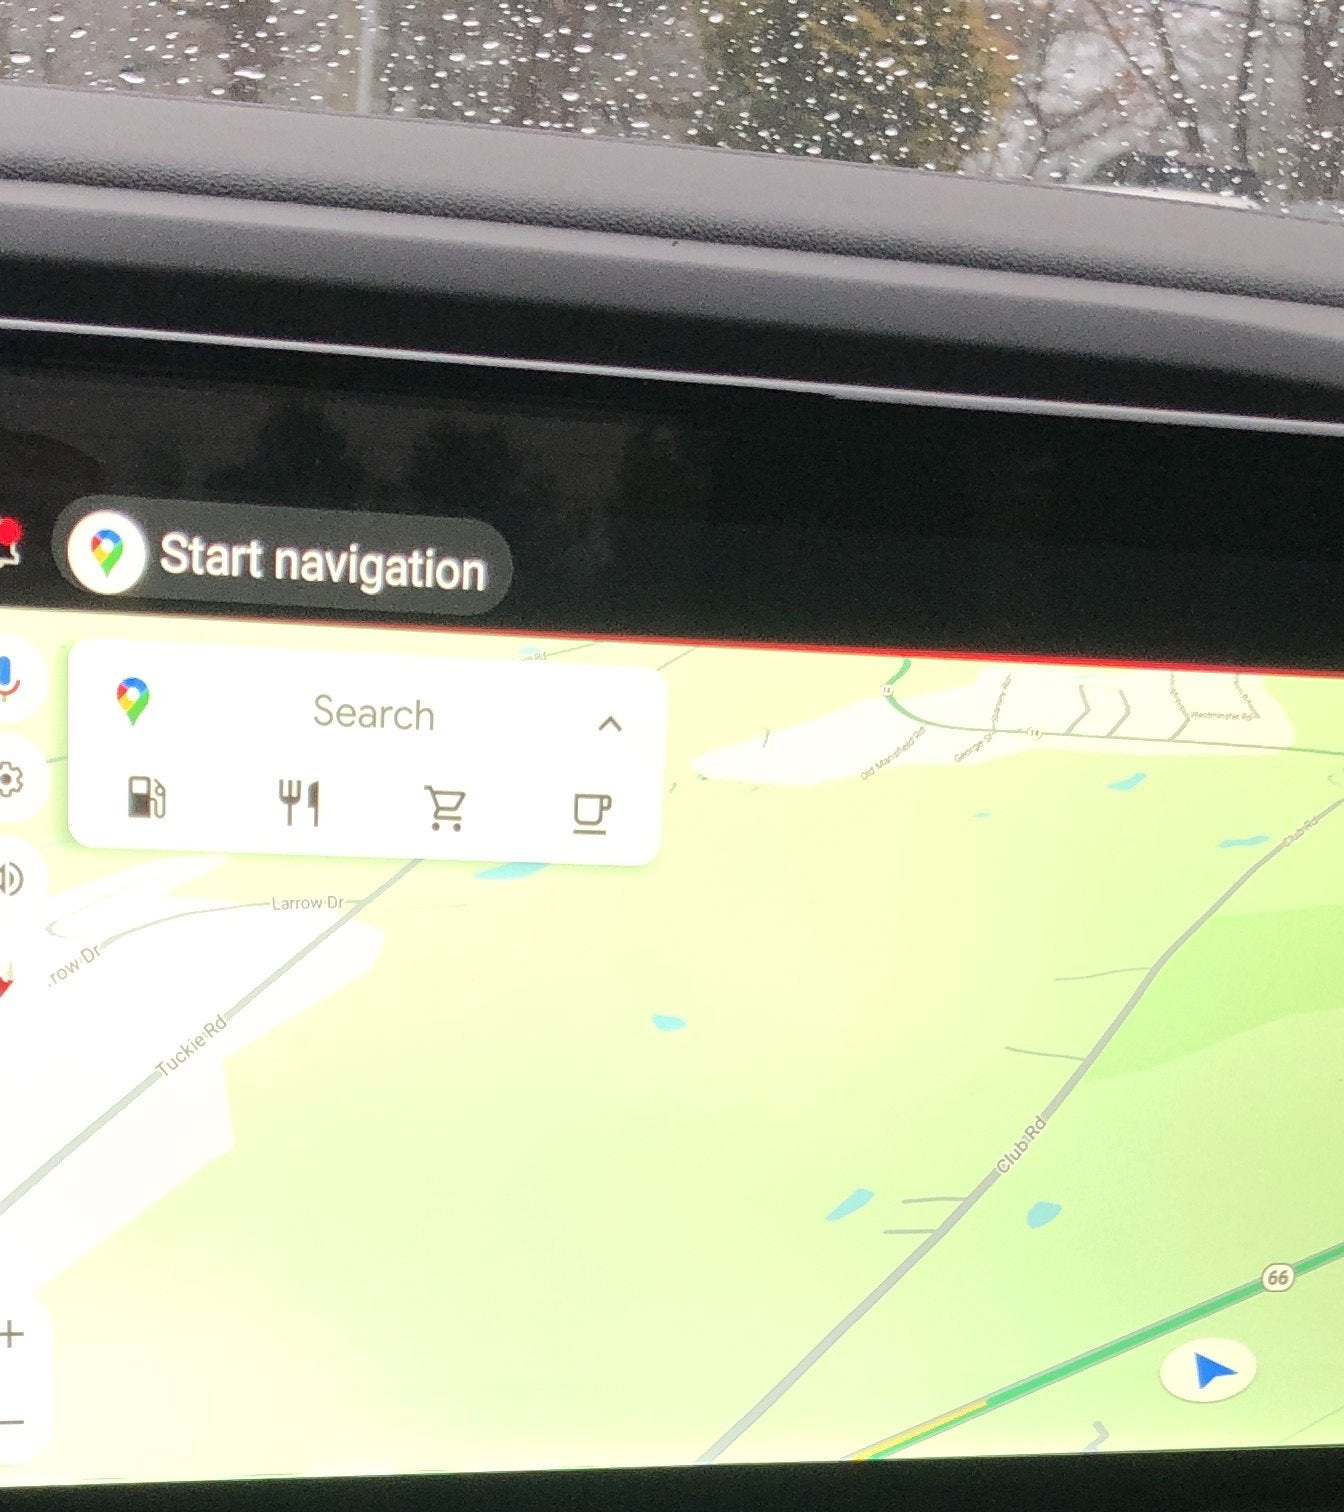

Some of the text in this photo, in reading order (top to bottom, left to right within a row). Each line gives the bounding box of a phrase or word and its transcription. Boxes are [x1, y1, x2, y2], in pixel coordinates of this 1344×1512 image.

[160, 532, 488, 593] Start navigation
[313, 693, 436, 732] Search
[953, 741, 984, 763] George
[271, 895, 345, 911] Larrow Dr
[79, 944, 101, 964] Dr
[154, 1014, 229, 1080] Tuckie Rd
[996, 1115, 1048, 1176] Club Rd
[1266, 1267, 1290, 1288] 66
